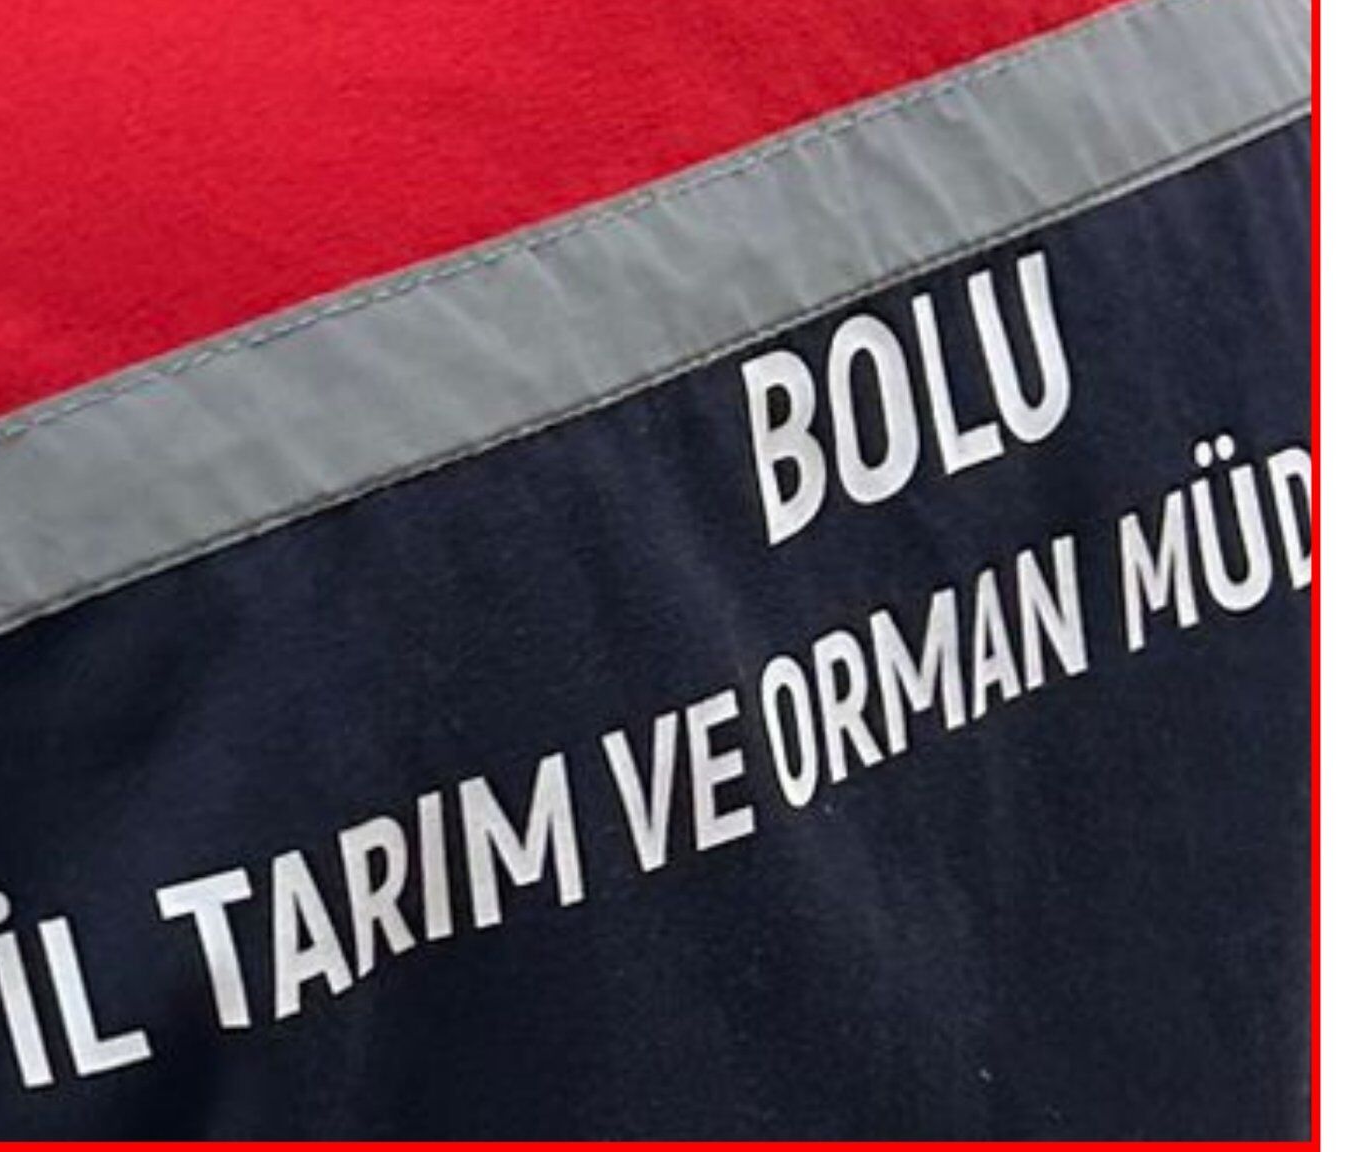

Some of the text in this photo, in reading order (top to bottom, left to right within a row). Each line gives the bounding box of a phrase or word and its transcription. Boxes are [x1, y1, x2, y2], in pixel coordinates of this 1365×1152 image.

[742, 252, 1070, 545] BOLU
[157, 753, 584, 1028] TARIM
[602, 689, 755, 872] VE
[761, 536, 1088, 807] ORMAN
[1120, 434, 1313, 652] MÜD
